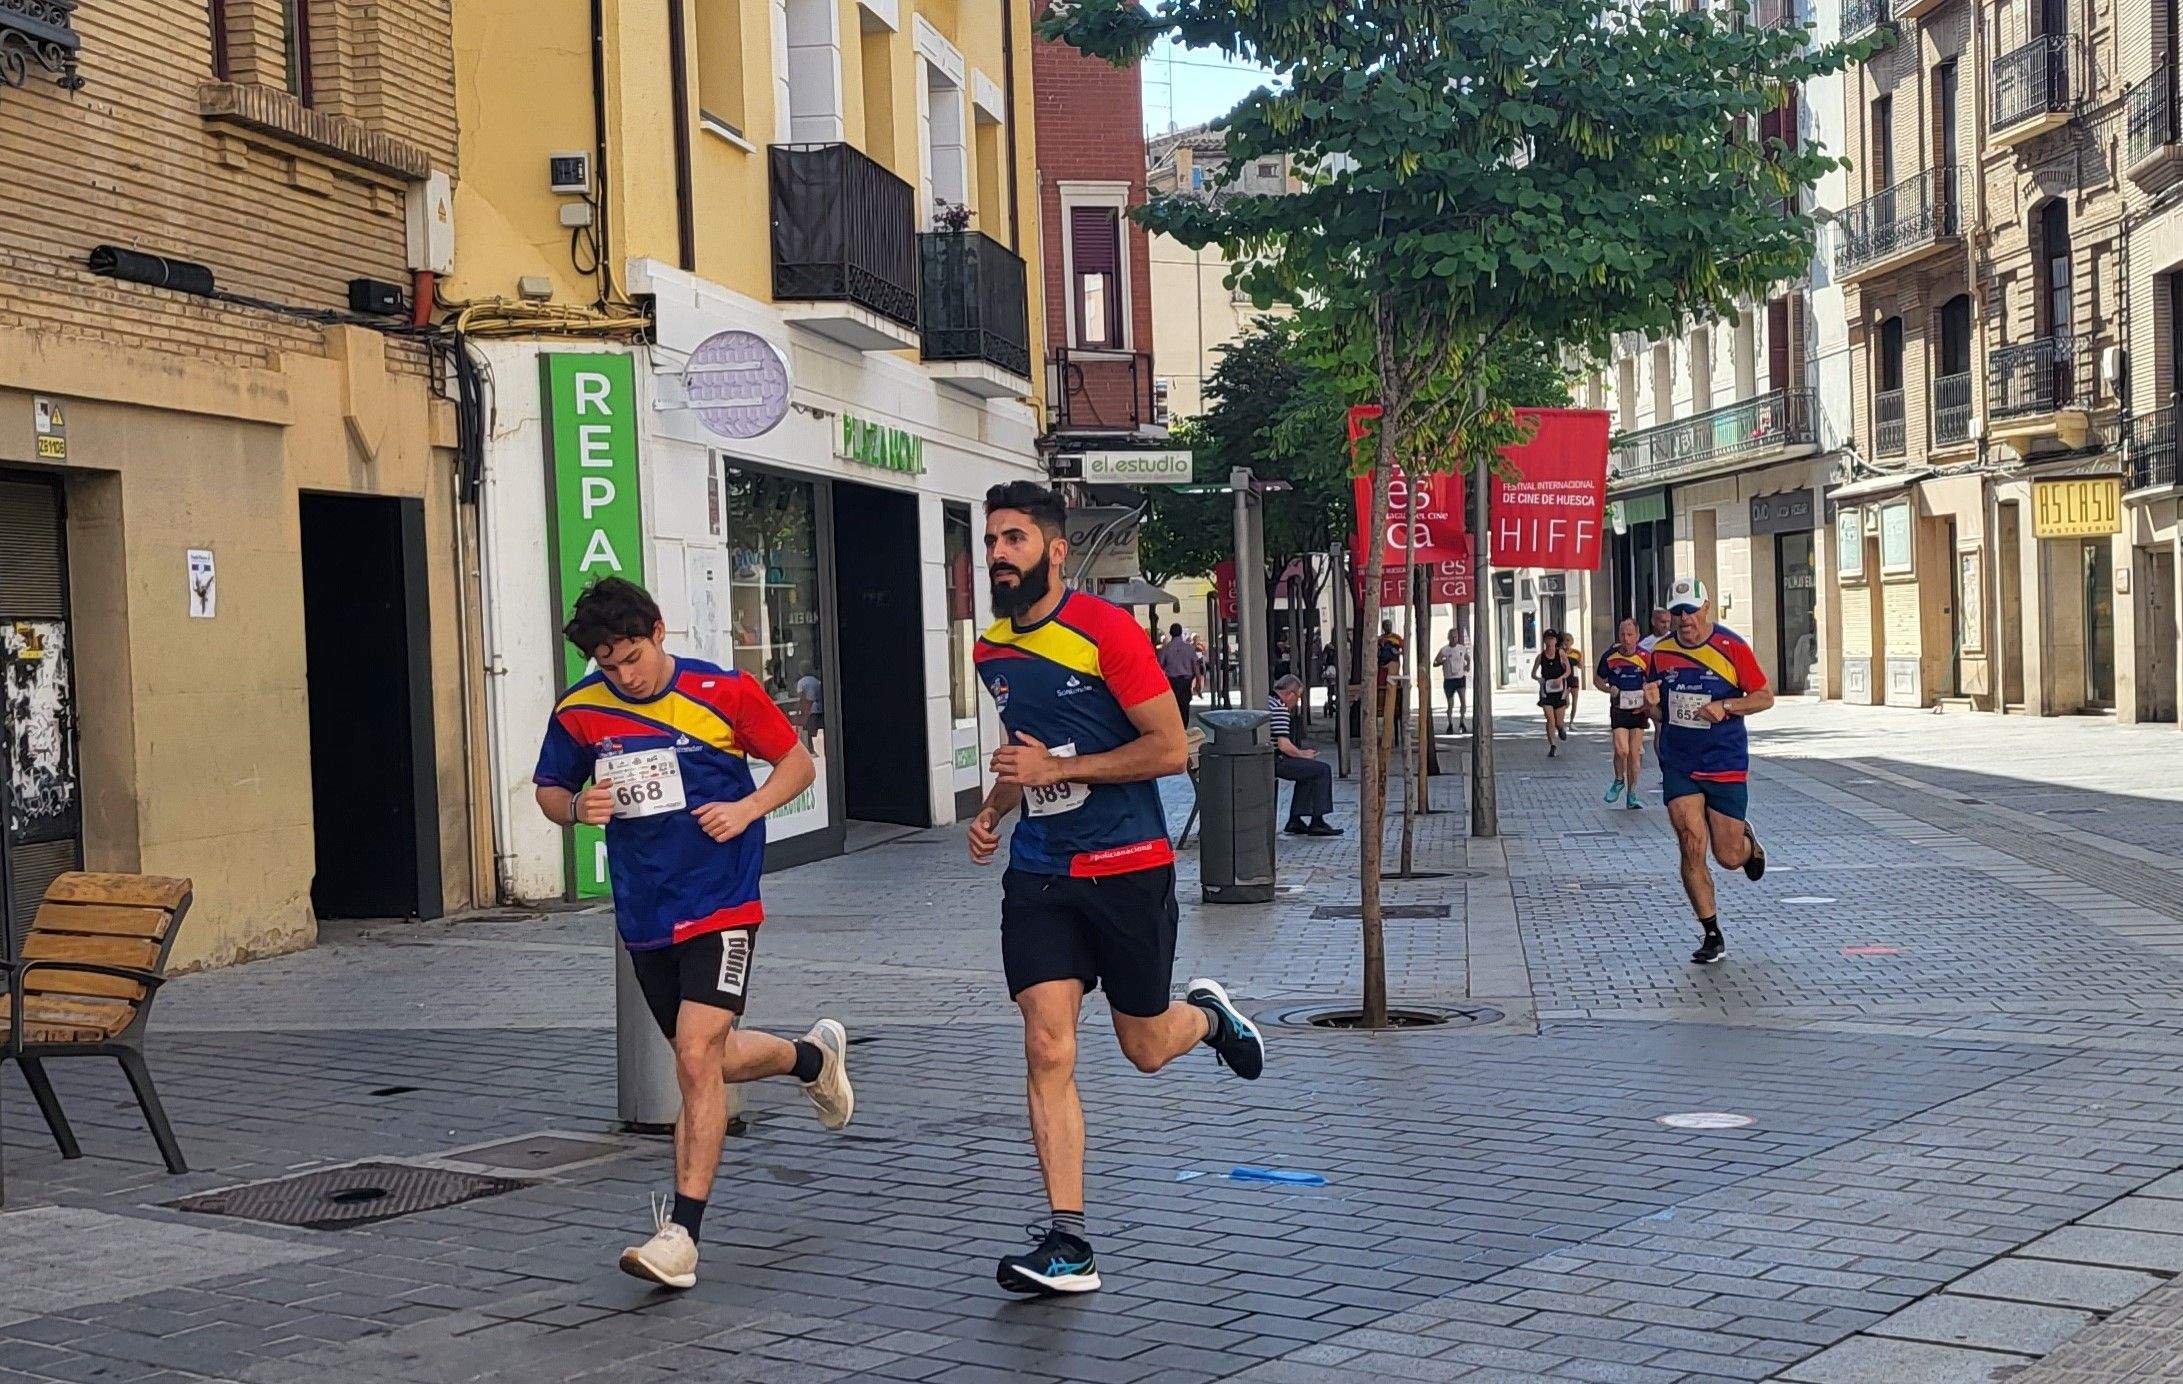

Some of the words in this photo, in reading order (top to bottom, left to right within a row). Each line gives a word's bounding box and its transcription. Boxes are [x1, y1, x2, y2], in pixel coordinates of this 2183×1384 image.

[1091, 454, 1188, 474] el.estudio
[1502, 492, 1516, 504] DE
[1517, 492, 1540, 504] CINE
[1541, 493, 1554, 505] DE
[1556, 494, 1595, 506] HUESCA
[1503, 482, 1536, 492] FESTIVAL
[1537, 480, 1595, 490] INTERNACIONAL
[2039, 482, 2115, 525] ASCASO
[1500, 517, 1594, 554] HIFF
[616, 780, 663, 806] 668
[1030, 780, 1071, 806] 389
